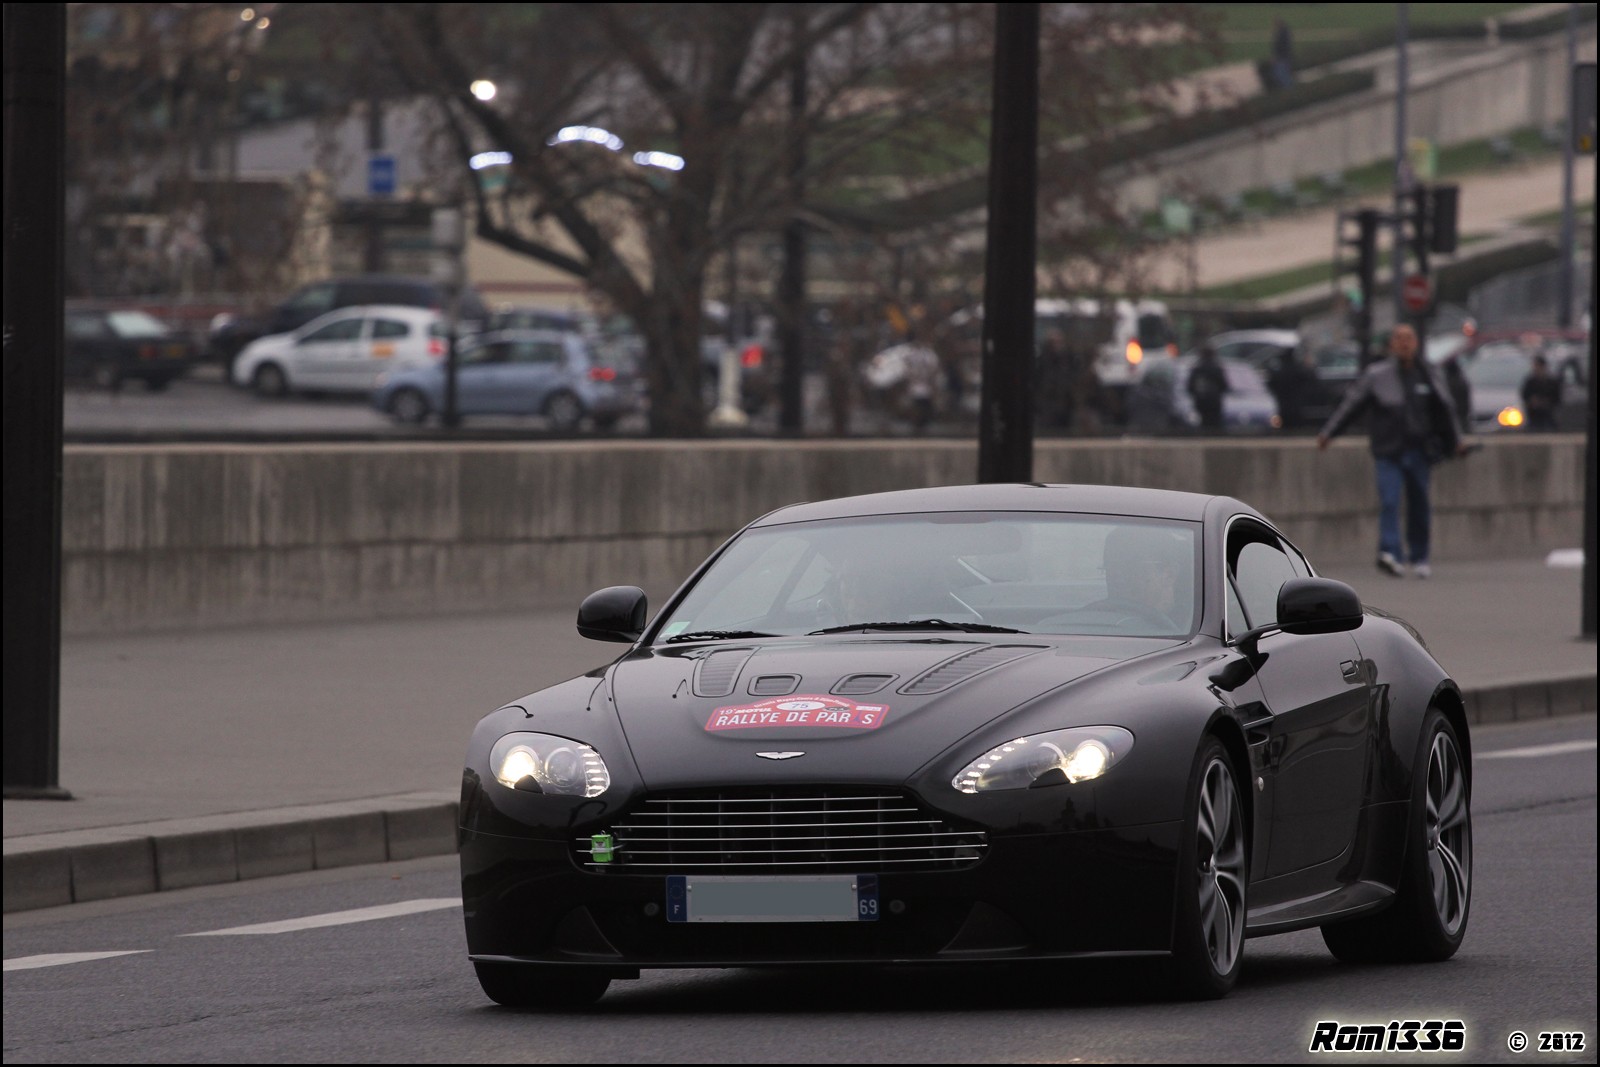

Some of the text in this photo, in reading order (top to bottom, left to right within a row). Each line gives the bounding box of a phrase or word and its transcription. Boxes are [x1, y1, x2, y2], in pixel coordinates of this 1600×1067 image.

[716, 712, 780, 726] RALLYE
[785, 711, 810, 722] DE
[673, 905, 680, 914] F
[859, 899, 878, 915] 69
